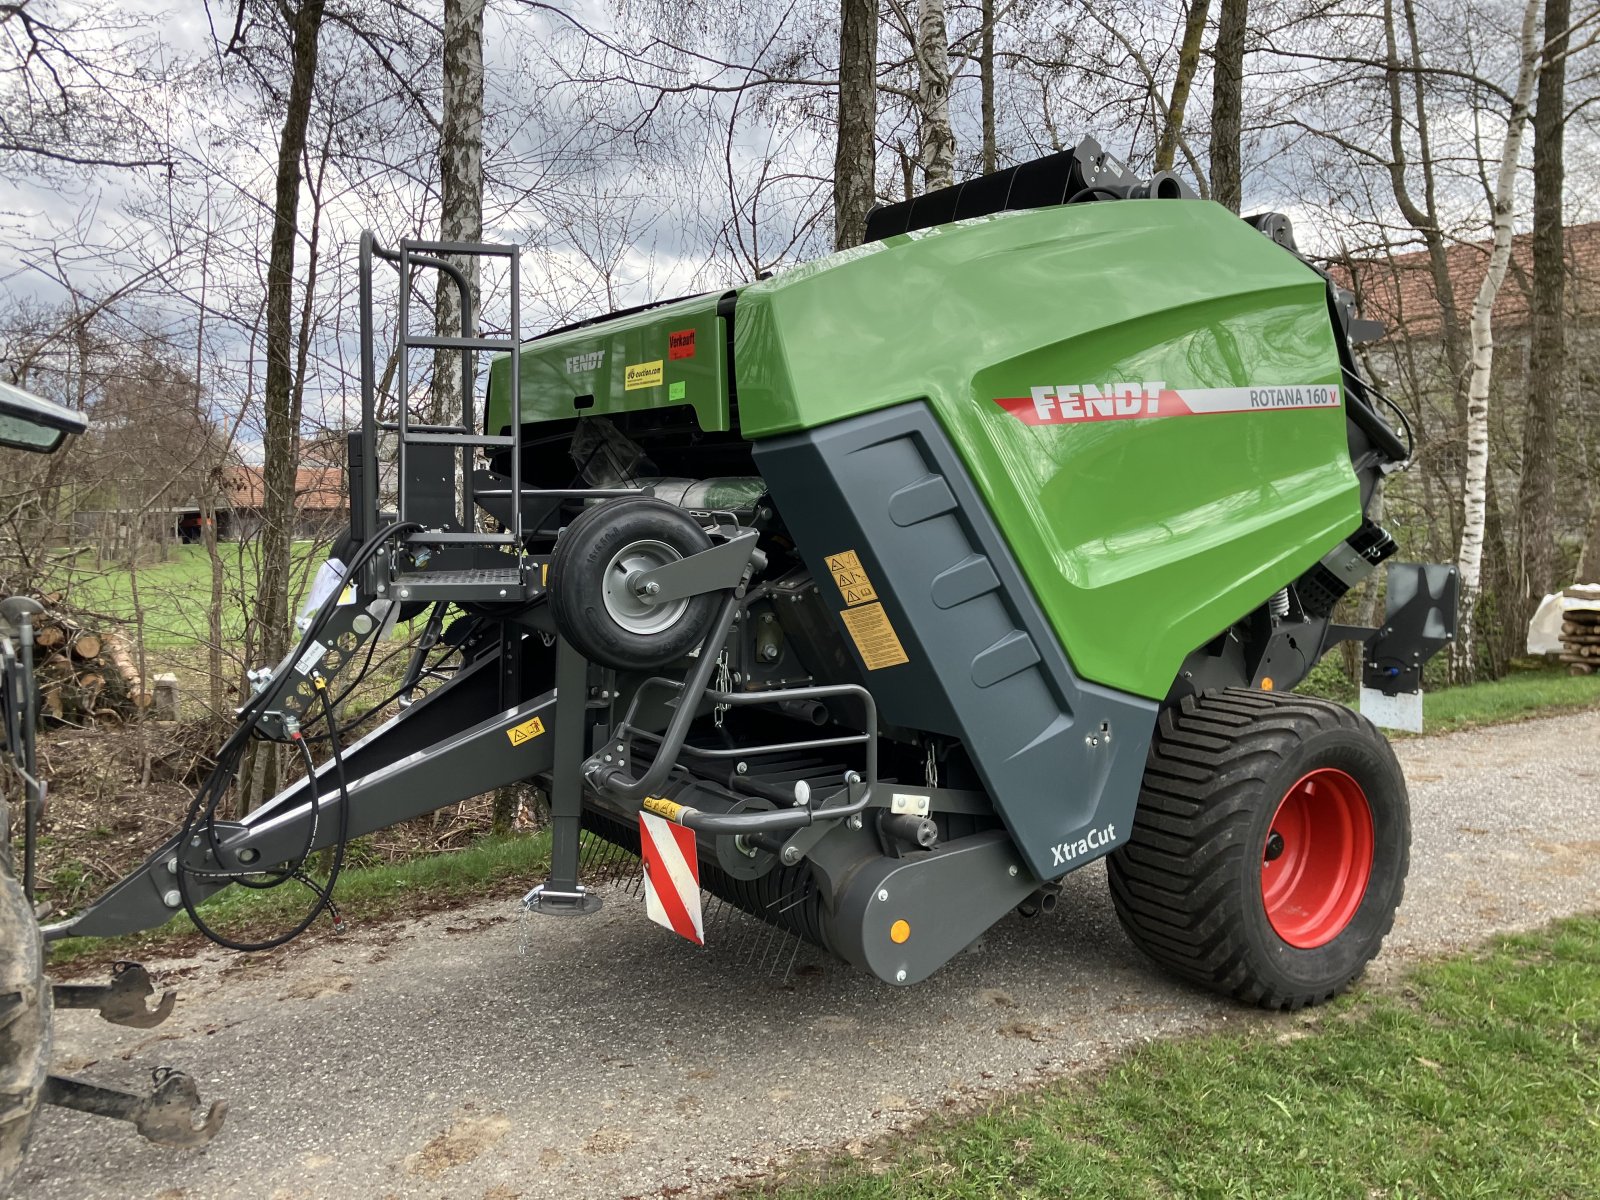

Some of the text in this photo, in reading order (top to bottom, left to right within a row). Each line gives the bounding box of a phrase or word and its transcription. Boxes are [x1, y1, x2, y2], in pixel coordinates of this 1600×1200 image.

[670, 332, 695, 348] Verkauft
[566, 350, 606, 374] FENDT
[1030, 381, 1166, 420] FENDT
[1250, 388, 1303, 408] ROTANA
[1307, 387, 1328, 405] 160
[1050, 823, 1116, 867] XtraCut
